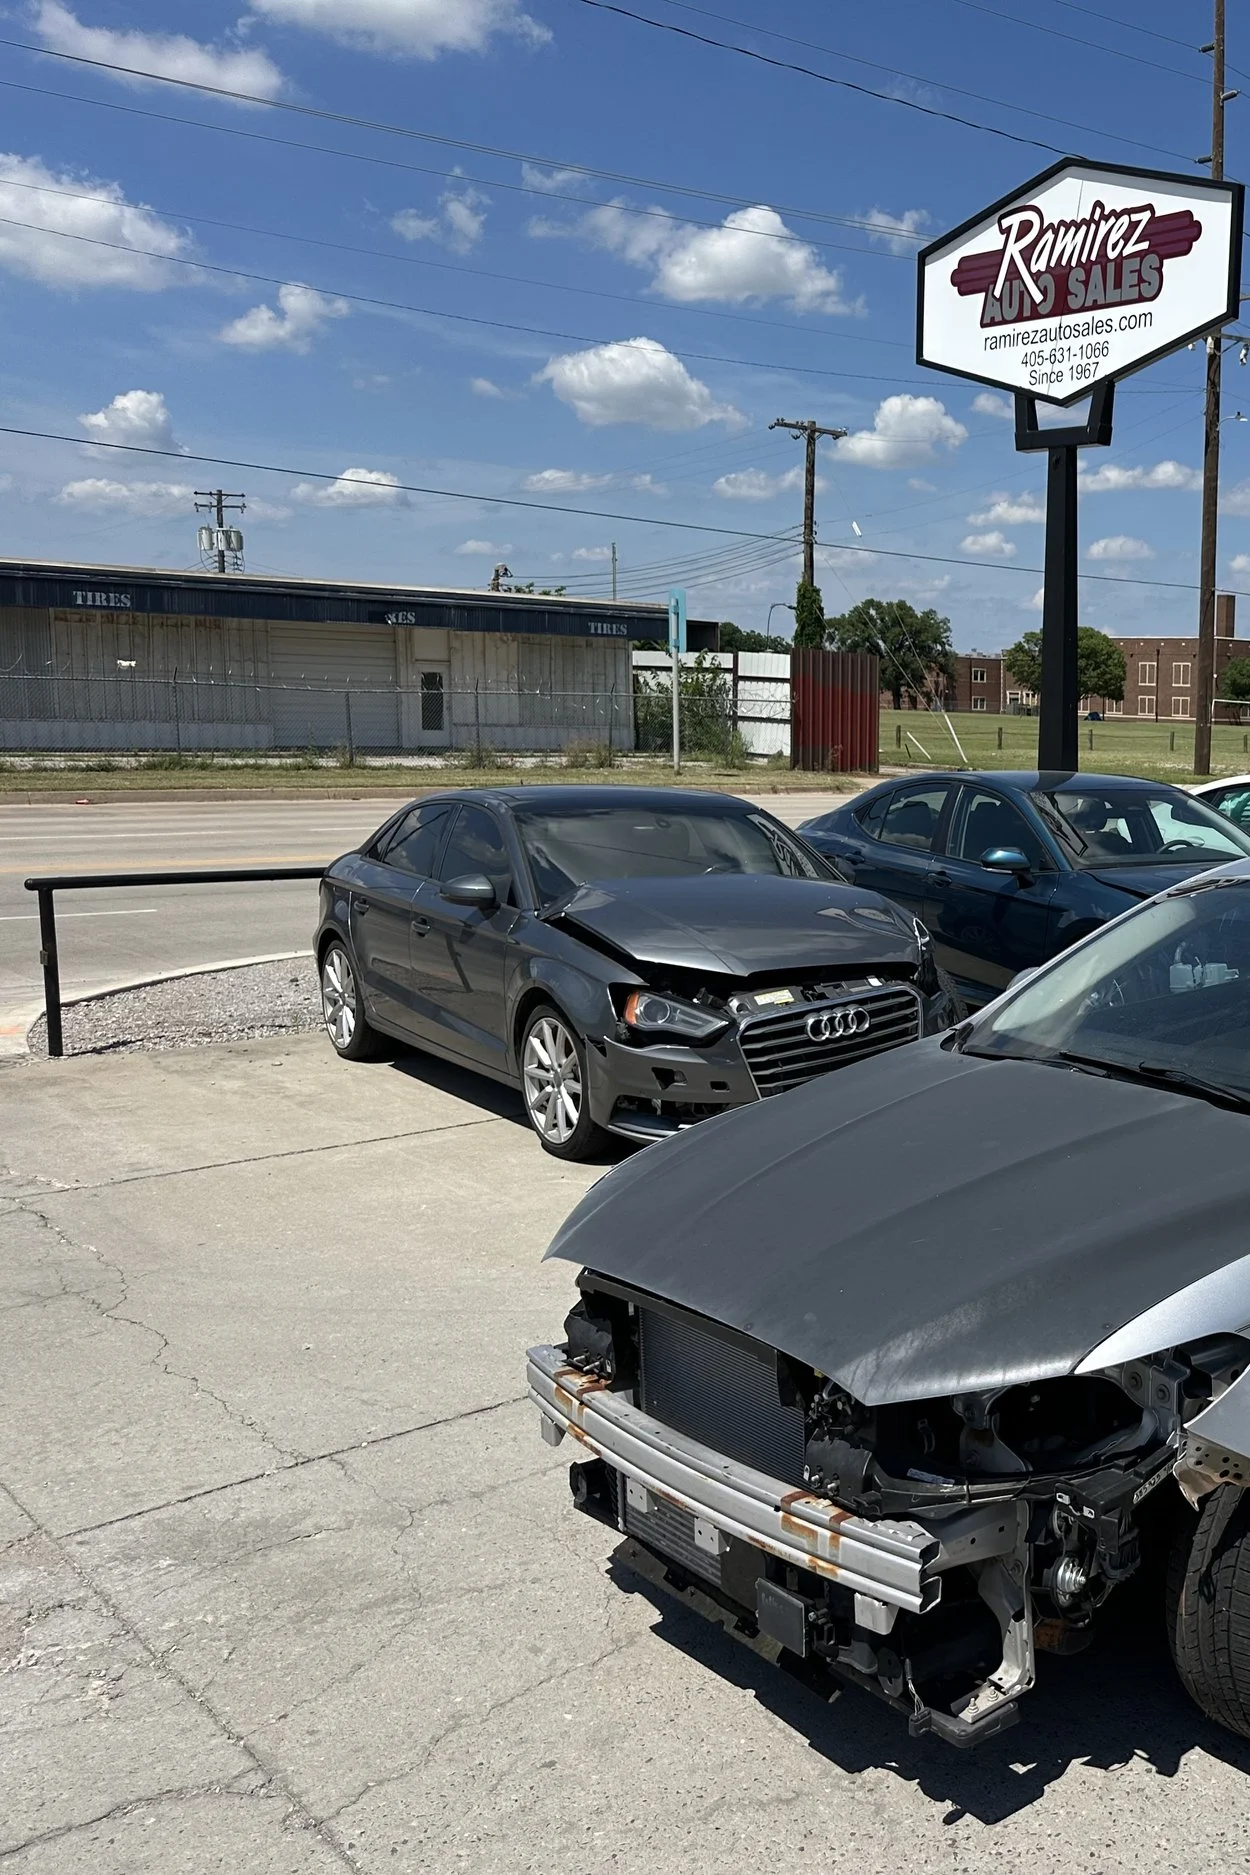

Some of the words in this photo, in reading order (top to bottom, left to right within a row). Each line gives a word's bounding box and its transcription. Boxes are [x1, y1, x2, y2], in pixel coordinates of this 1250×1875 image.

[993, 206, 1151, 305] Ramirez
[983, 273, 1056, 324] AUTO
[1067, 254, 1160, 310] SALES
[984, 311, 1153, 351] ramirezautosales.com
[1021, 341, 1110, 368] 405-631-1066
[1028, 368, 1064, 386] Since
[1069, 361, 1100, 381] 1967
[72, 590, 130, 607] TIRES
[588, 622, 628, 635] TIRES
